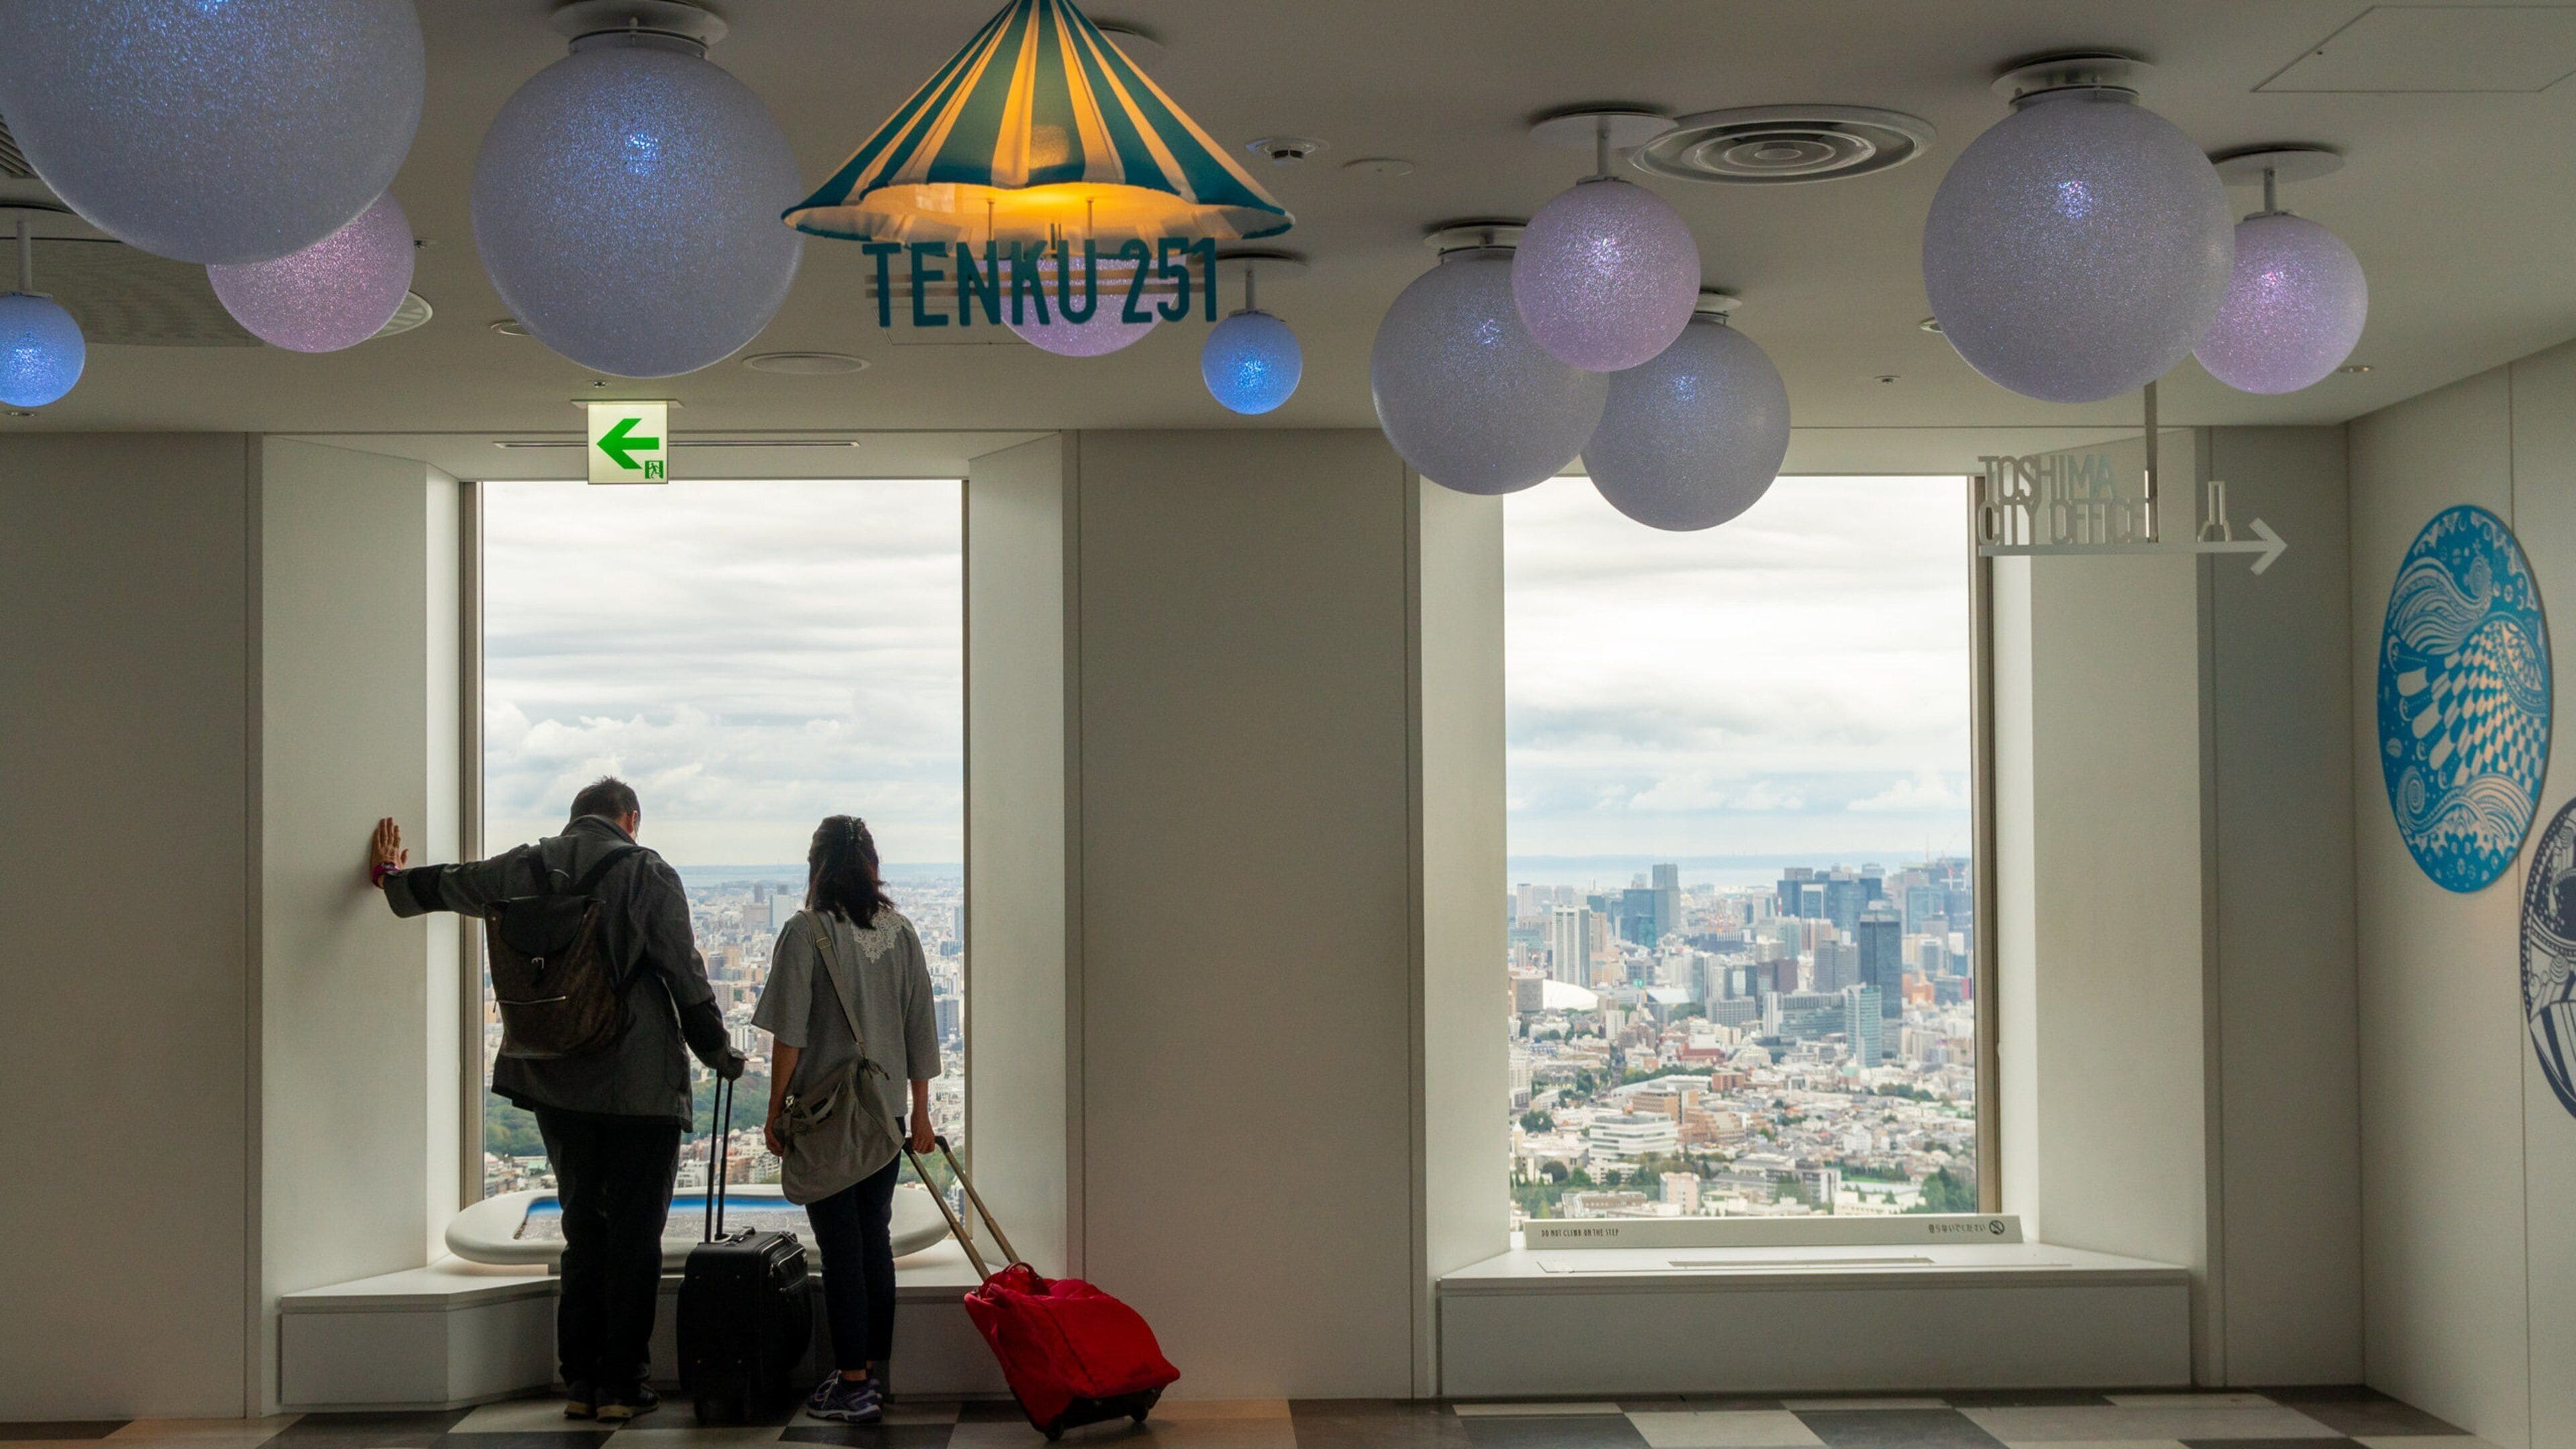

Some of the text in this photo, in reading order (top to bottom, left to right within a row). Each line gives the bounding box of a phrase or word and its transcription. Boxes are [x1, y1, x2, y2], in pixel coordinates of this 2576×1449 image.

[862, 237, 1218, 327] TENKU 251
[1978, 454, 2116, 501] TOSHIMA
[1978, 498, 2042, 546] CITY
[1541, 1229, 1549, 1238] DO
[1550, 1229, 1562, 1237] NOT
[1563, 1229, 1582, 1237] CLIMB
[1593, 1228, 1603, 1236] THE
[1605, 1228, 1619, 1236] STEP
